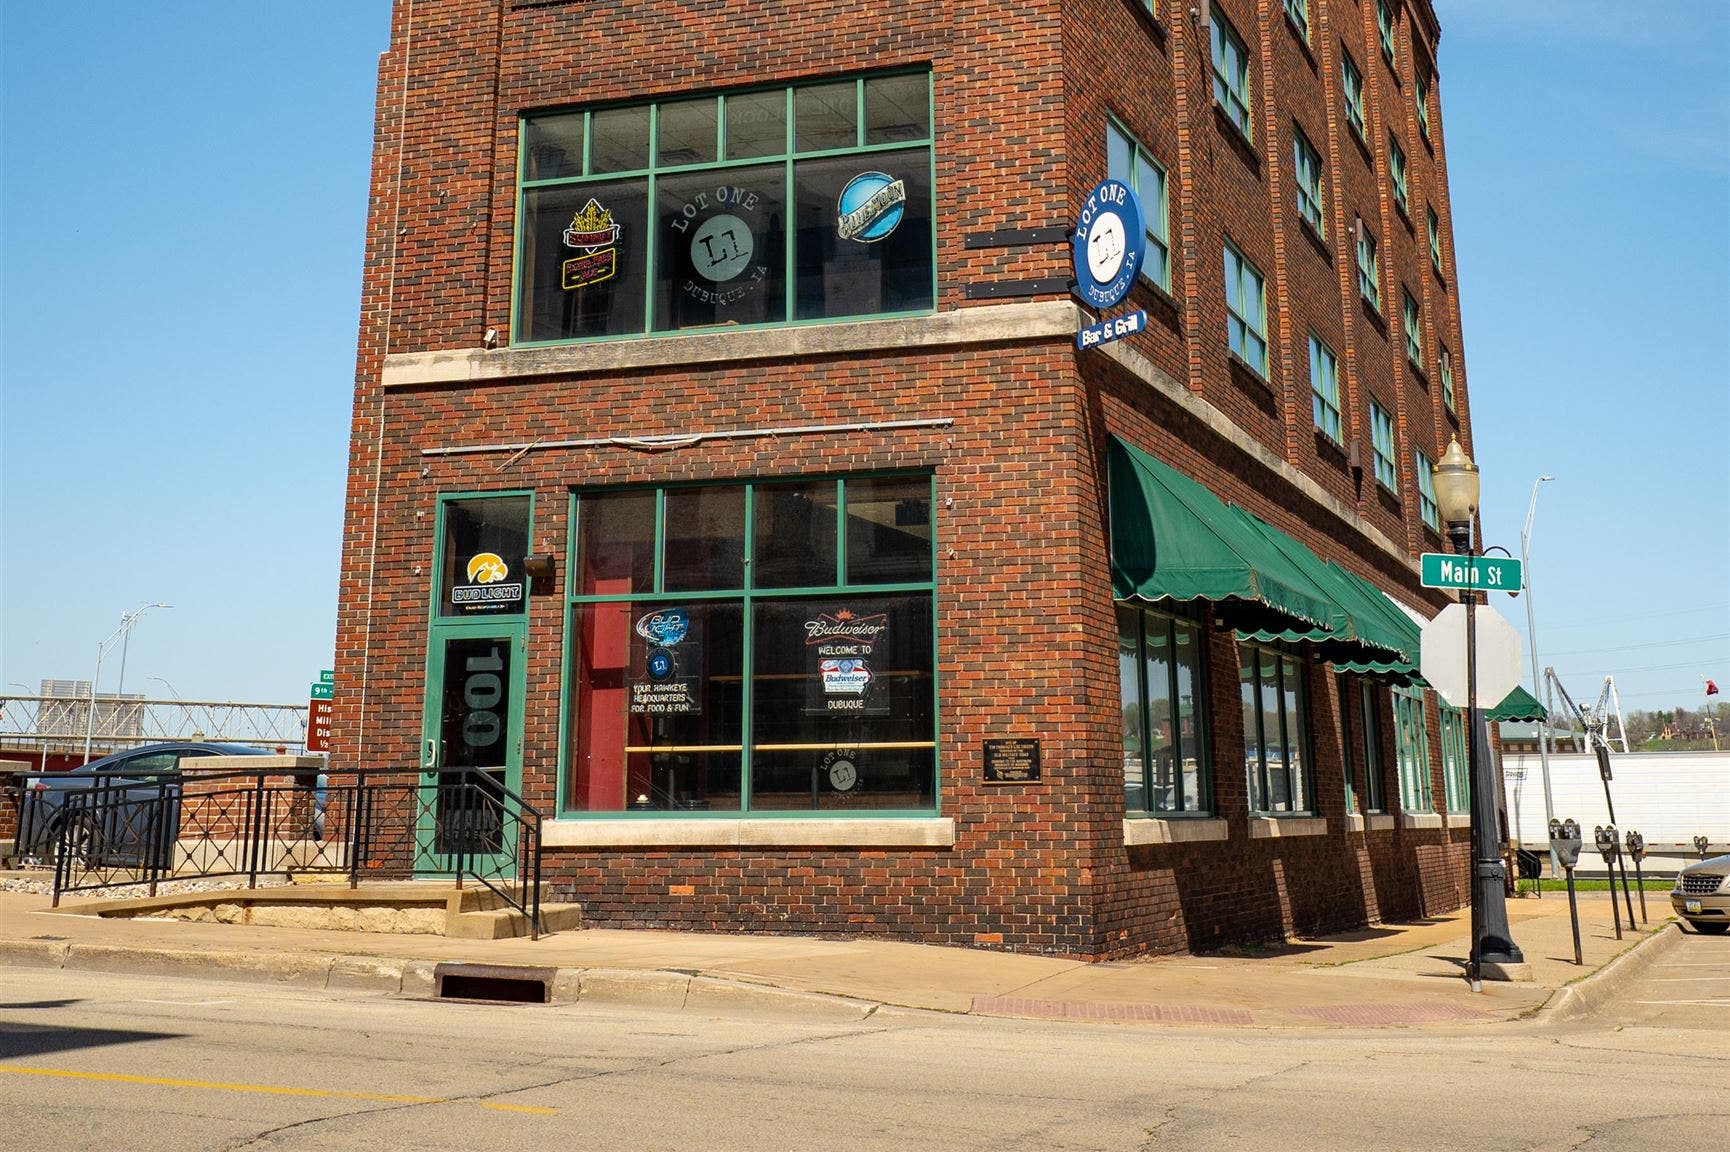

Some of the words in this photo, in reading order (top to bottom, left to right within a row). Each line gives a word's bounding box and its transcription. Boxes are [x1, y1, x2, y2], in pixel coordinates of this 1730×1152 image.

[671, 192, 709, 233] LOT
[716, 186, 759, 211] ONE
[1077, 195, 1097, 241] LOT
[1100, 184, 1126, 206] ONE
[683, 280, 746, 306] DUBUQUE
[1082, 328, 1101, 346] Bar
[1104, 322, 1113, 339] &
[1115, 314, 1138, 336] Grill
[1440, 559, 1479, 584] Main
[1487, 565, 1502, 585] St
[454, 588, 480, 601] BUD
[481, 586, 519, 599] LIGHT
[650, 615, 680, 625] BUD
[804, 621, 885, 637] Budweiser
[818, 645, 858, 655] WELCOME
[861, 645, 872, 654] TO
[825, 674, 867, 684] Budweiser
[314, 686, 327, 696] 9th
[633, 684, 651, 693] YOUR
[653, 683, 688, 693] HAWKEYE
[462, 646, 503, 747] 100
[633, 694, 686, 704] HEADQUARTERS
[631, 704, 645, 713] FOR
[647, 704, 665, 713] FOOD
[666, 704, 673, 712] &
[674, 703, 689, 713] FUN
[827, 699, 864, 710] DUBUQUE
[820, 751, 835, 770] LOT
[837, 748, 856, 759] ONE
